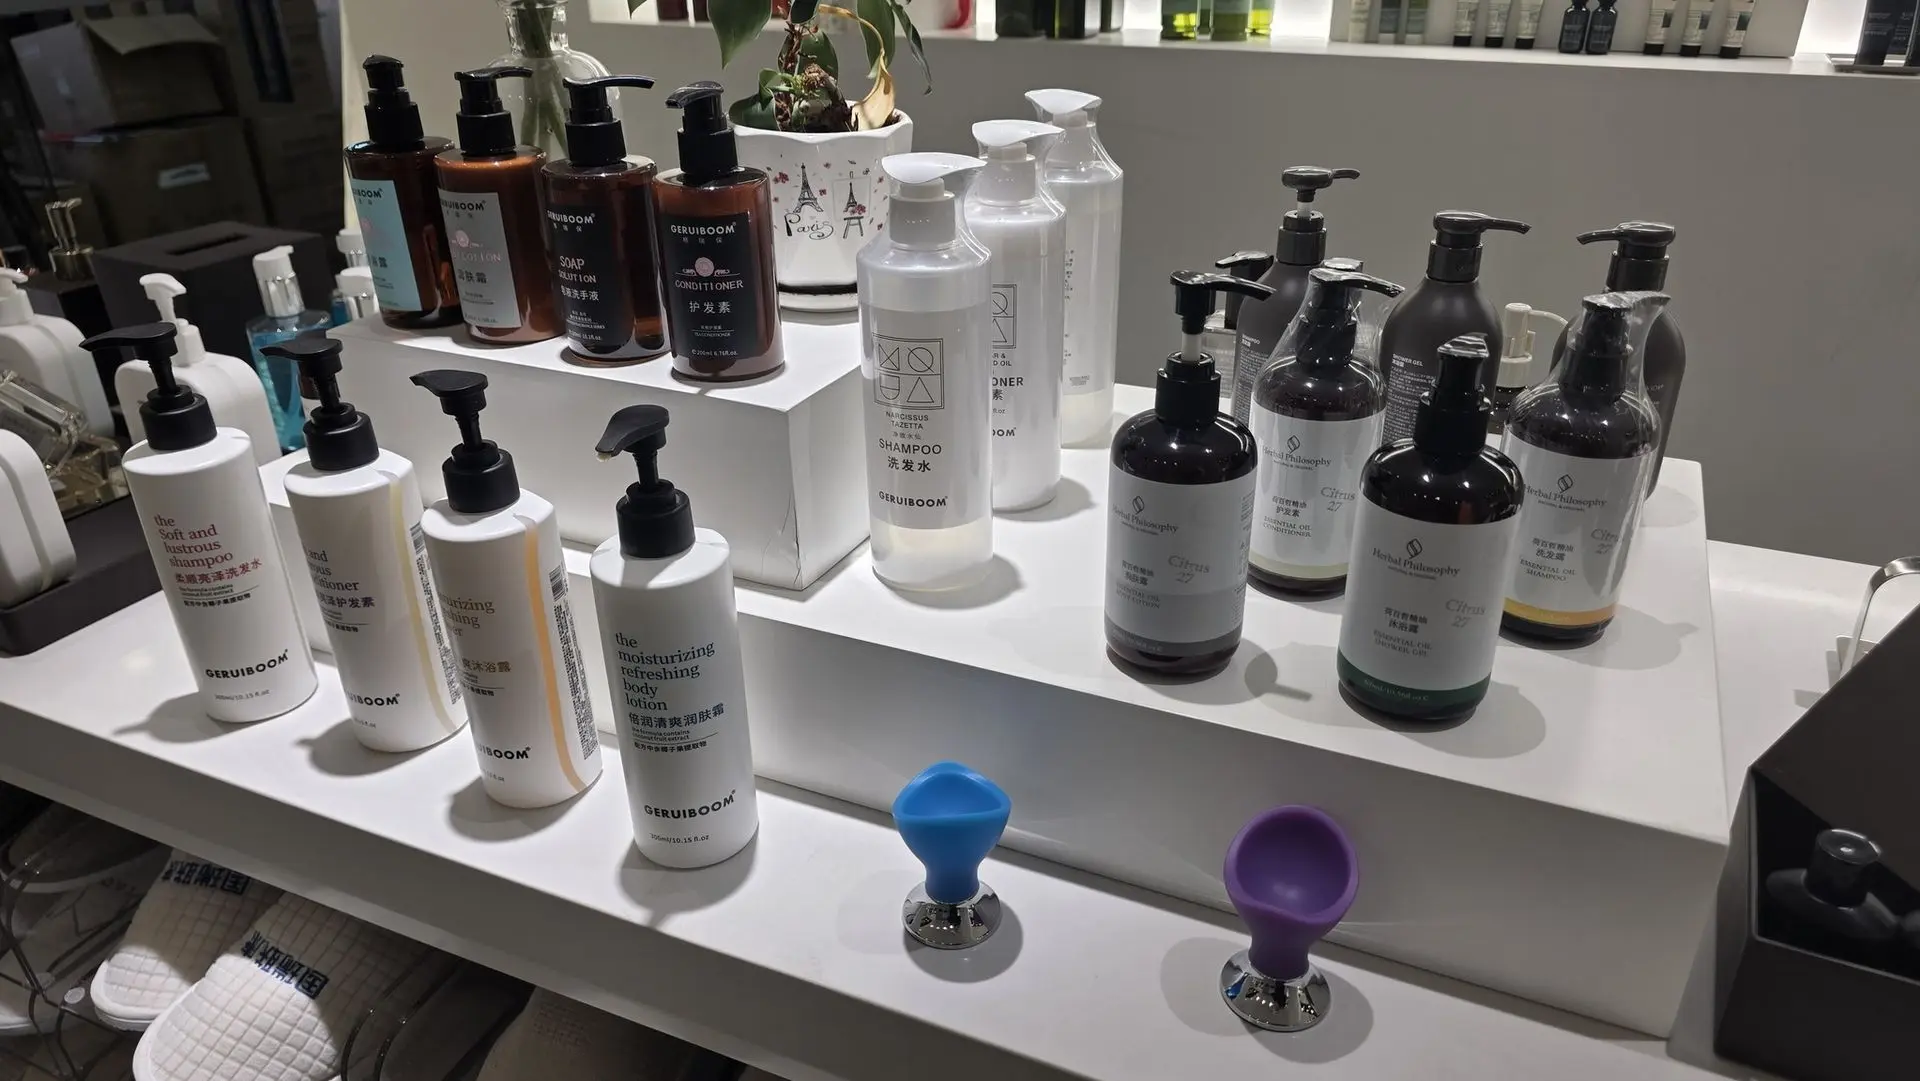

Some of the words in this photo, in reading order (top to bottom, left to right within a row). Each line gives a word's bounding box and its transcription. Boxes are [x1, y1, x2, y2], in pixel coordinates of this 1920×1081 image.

[671, 224, 735, 235] GERUIBOOM
[784, 212, 834, 240] Paris
[559, 255, 585, 270] SOAP
[558, 270, 597, 283] SOLUTION
[675, 279, 744, 291] CONDITIONER
[689, 301, 731, 314] 护发素
[886, 411, 929, 421] NARCISSUS
[891, 421, 924, 430] TAZETTA
[879, 438, 942, 455] SHAMPOO
[888, 455, 931, 472] 洗发水
[1285, 454, 1331, 467] Philosophy
[879, 490, 947, 507] GERUIBOOM
[1321, 486, 1356, 501] Citrus
[1524, 484, 1552, 500] Herbal
[1553, 491, 1607, 508] Philosophy
[1327, 501, 1342, 512] 27
[154, 513, 176, 527] the
[1131, 514, 1179, 534] Philosophy
[159, 528, 185, 541] Soft
[189, 524, 218, 540] and
[1263, 522, 1312, 537] CONDITIONER
[164, 541, 222, 554] lustrous
[169, 552, 233, 569] shampoo
[1168, 554, 1210, 574] Citrus
[1372, 547, 1402, 566] Herbal
[1403, 558, 1461, 577] Philosophy
[1520, 559, 1560, 575] ESSENTIAL
[175, 557, 262, 584] 柔顺亮泽洗发水
[1176, 571, 1194, 584] 27
[1526, 568, 1566, 582] SHAMPOO
[1445, 599, 1486, 616] Citrus
[1451, 615, 1471, 628] 27
[615, 632, 639, 648] the
[618, 642, 716, 665] moisturizing
[205, 652, 288, 678] GERUIBOOM
[620, 664, 700, 680] refreshing
[623, 678, 658, 698] body
[625, 693, 668, 711] lotion
[629, 702, 725, 729] 倍润清爽润肤霜
[663, 729, 690, 737] contains
[668, 734, 690, 742] extract
[644, 793, 734, 819] GERUIBOOM
